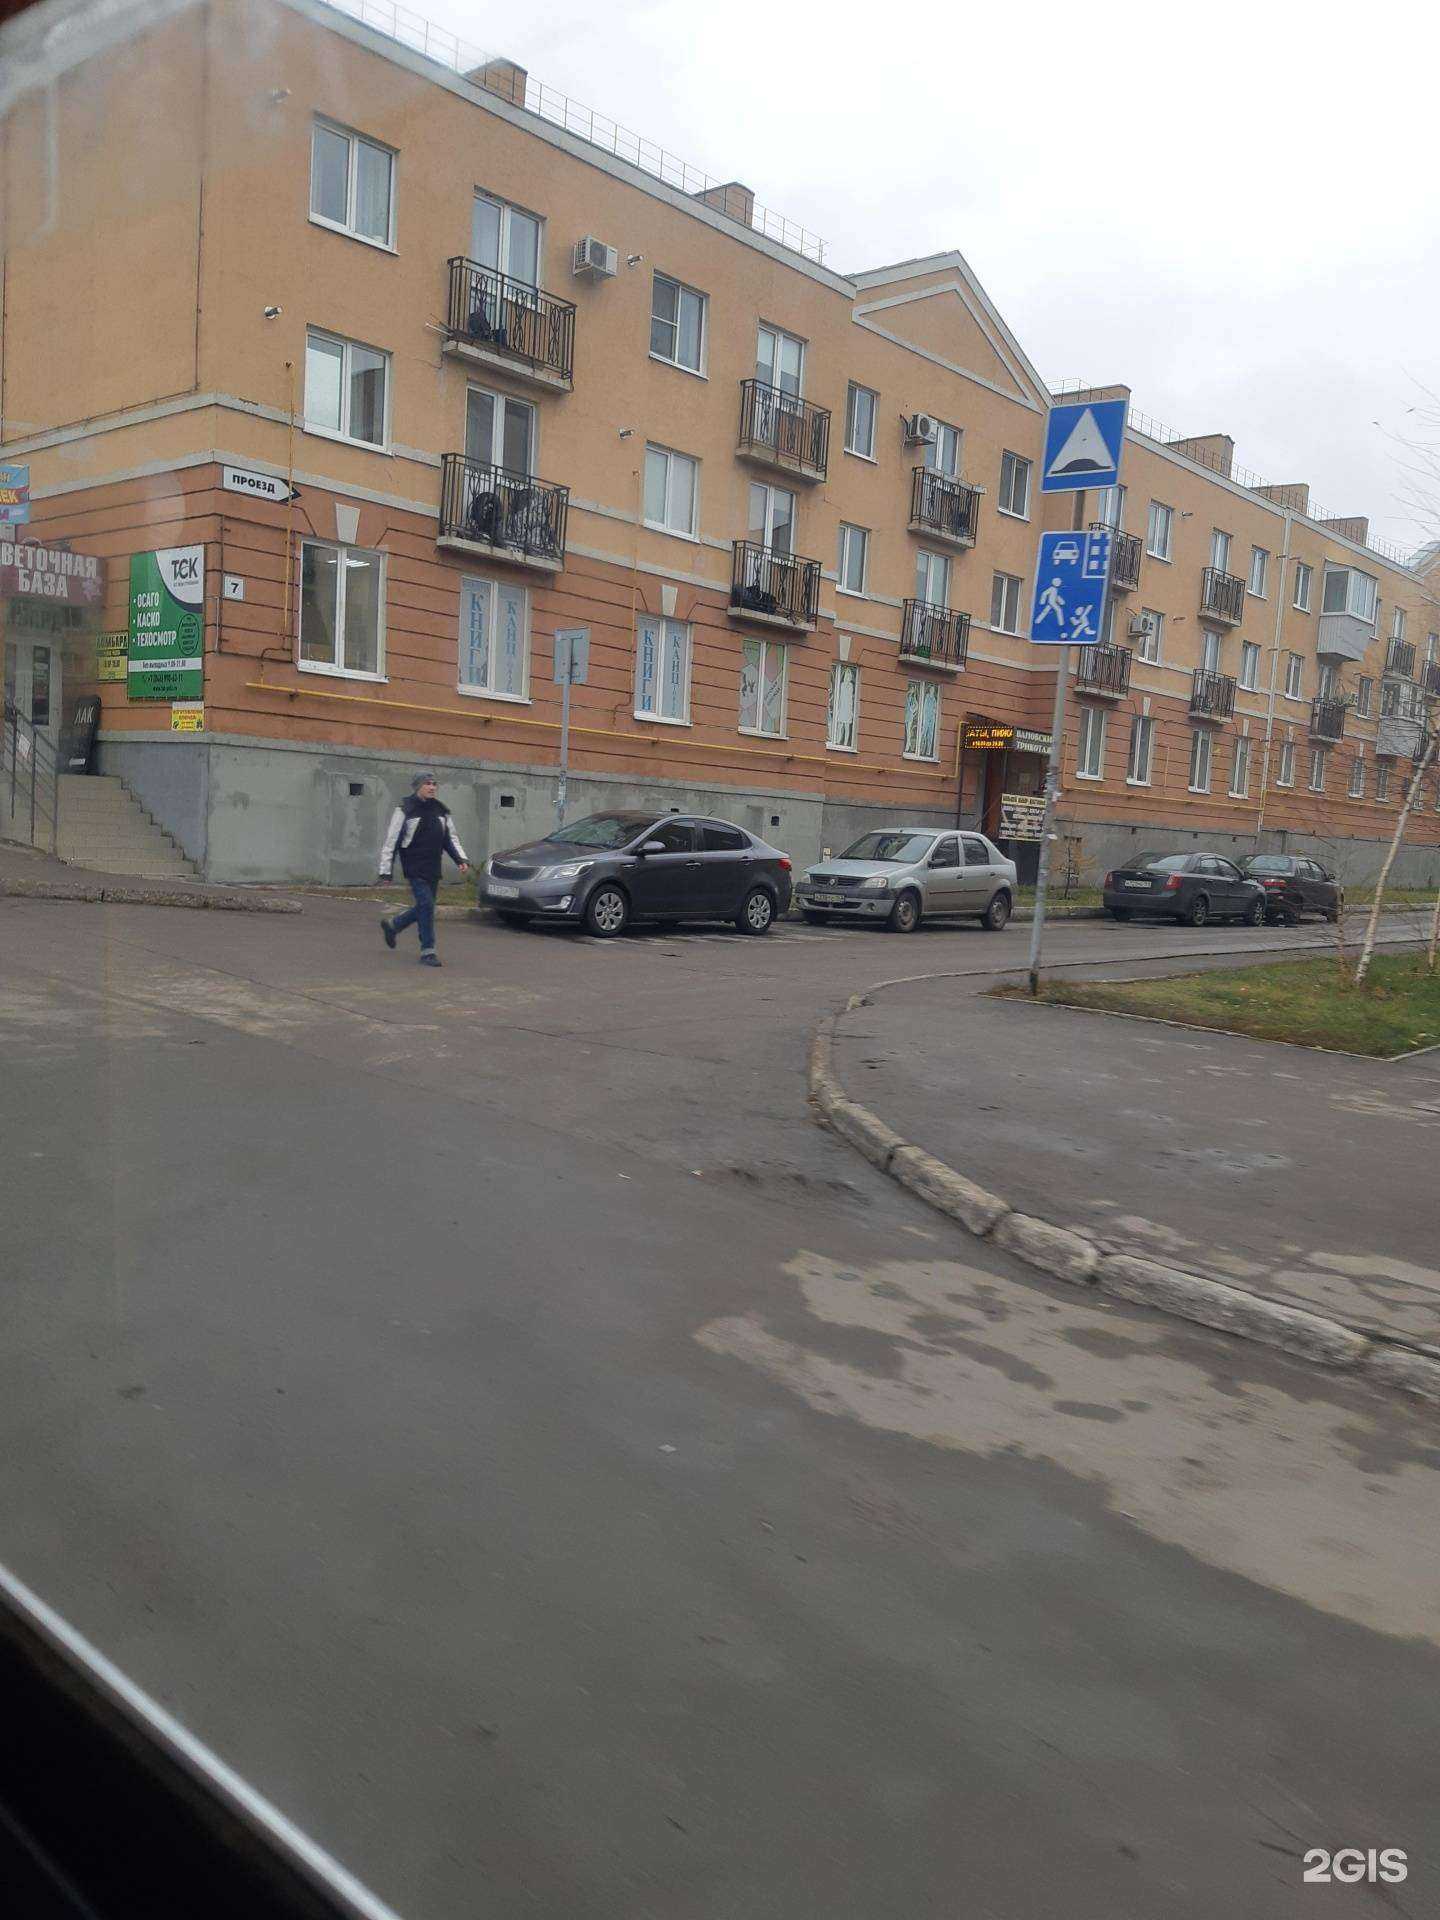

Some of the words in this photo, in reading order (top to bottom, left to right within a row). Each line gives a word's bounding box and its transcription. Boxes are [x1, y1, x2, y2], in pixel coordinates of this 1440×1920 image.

[232, 474, 276, 494] ПРОЕЗД
[19, 568, 68, 598] БАЗА
[231, 582, 239, 594] 7
[137, 591, 159, 608] ОСАГО
[137, 611, 160, 628] КАСКО
[137, 631, 177, 647] ТЕХОСМОТР
[642, 630, 654, 710] КНИГИ
